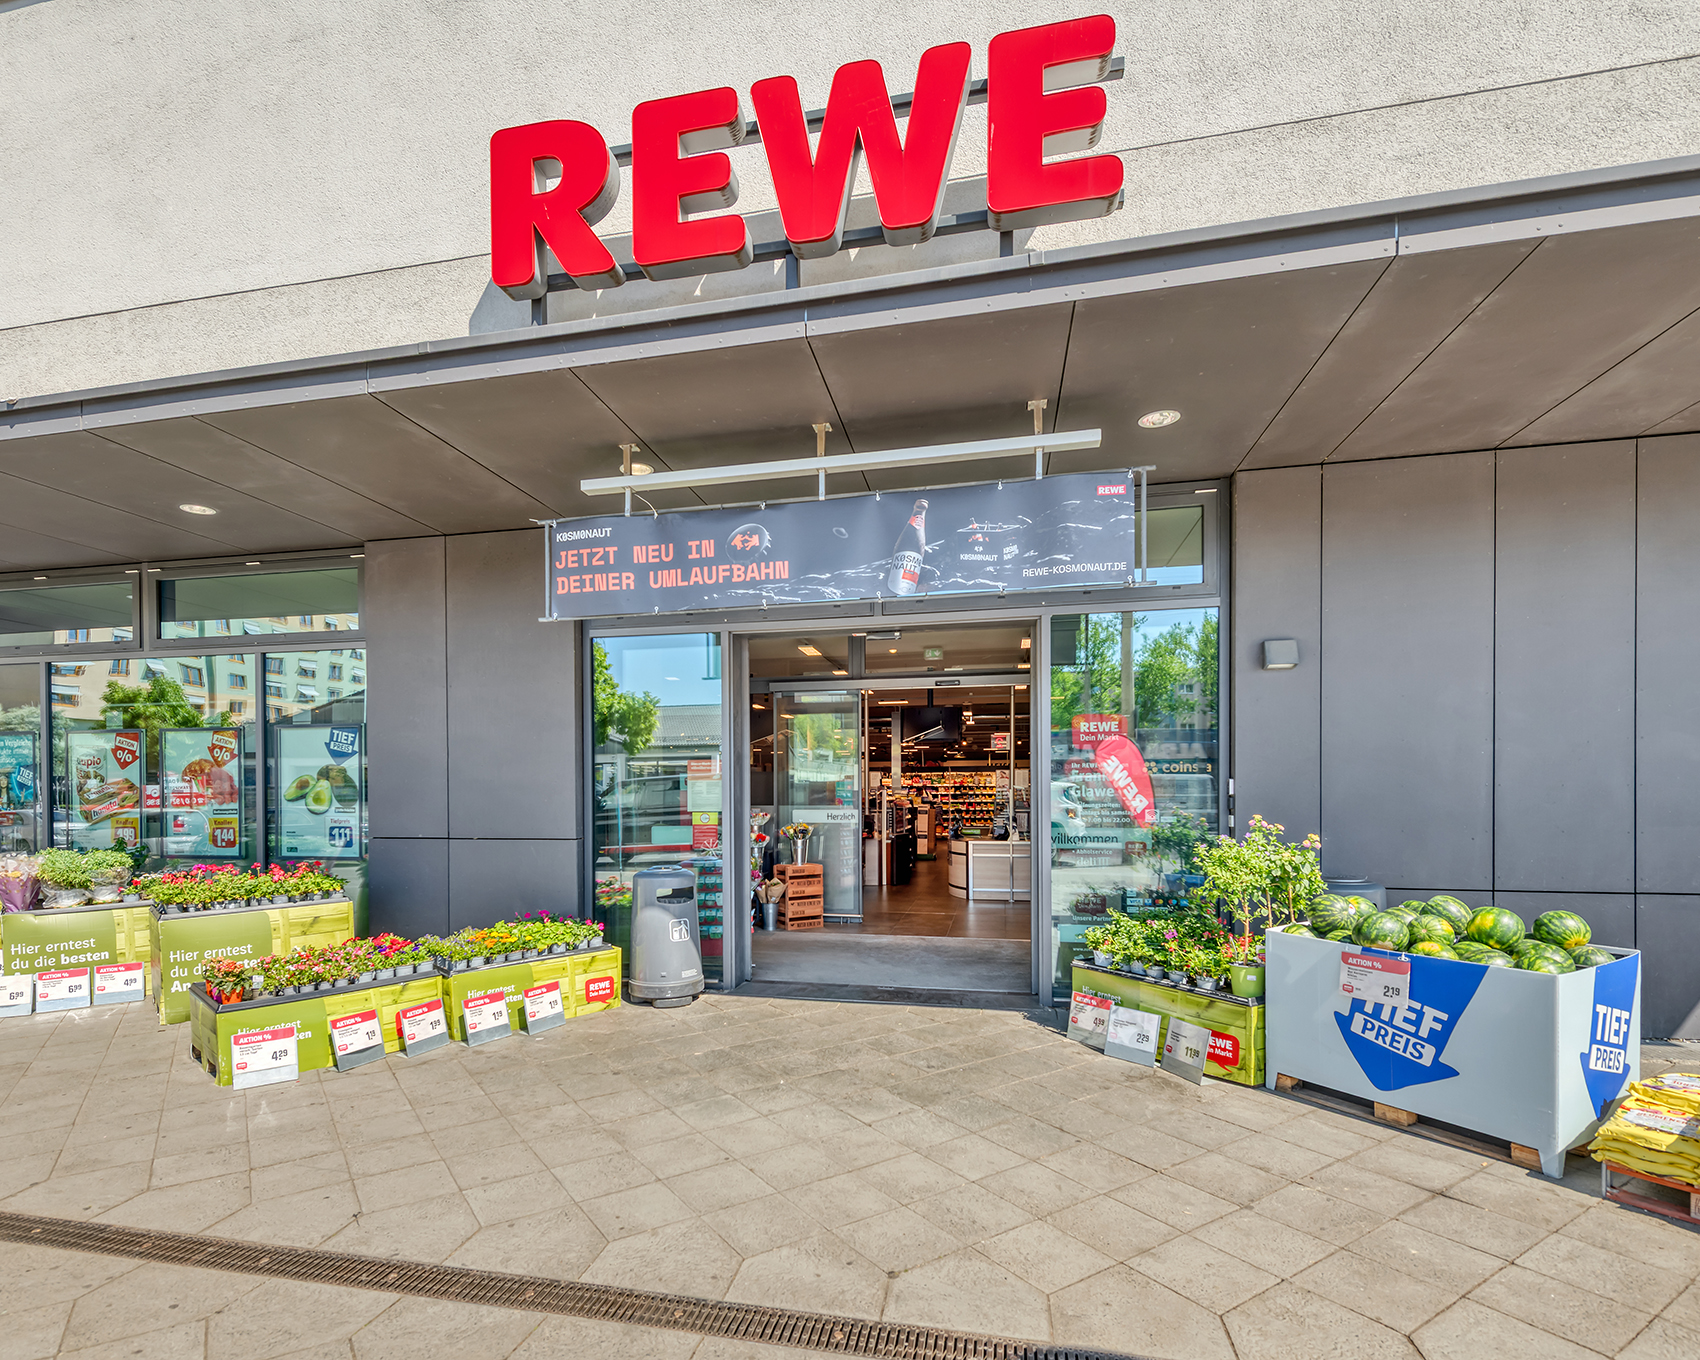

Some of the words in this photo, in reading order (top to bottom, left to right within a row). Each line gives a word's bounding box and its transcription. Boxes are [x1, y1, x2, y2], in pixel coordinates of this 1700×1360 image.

[490, 14, 1124, 297] REWE
[1098, 485, 1126, 495] REWE
[555, 546, 619, 570] JETZT
[633, 543, 674, 564] NEU
[687, 539, 715, 559] IN
[1022, 561, 1127, 577] REWE-KOSMONAUT.DE
[556, 571, 636, 595] DEINER
[649, 560, 790, 590] UMLAUFBAHN
[1080, 721, 1120, 733] REWE
[215, 736, 233, 746] AKTION
[332, 729, 356, 745] TIEF
[1080, 733, 1096, 742] Dein
[1097, 733, 1119, 742] Markt
[118, 738, 136, 749] AKTION
[332, 742, 351, 752] PREIS
[116, 749, 133, 763] %
[213, 748, 230, 761] %
[1072, 784, 1116, 798] Glawe
[826, 811, 856, 821] Herzlich
[214, 828, 235, 847] 1.44
[10, 942, 40, 956] Hier
[45, 937, 96, 953] erntest
[169, 949, 200, 963] Hier
[203, 943, 253, 959] erntest
[11, 957, 29, 970] du
[34, 953, 56, 968] die
[60, 951, 110, 965] besten
[1347, 957, 1373, 967] AKTION
[1373, 961, 1382, 969] %
[170, 965, 188, 978] du
[123, 978, 137, 987] 4.99
[588, 980, 611, 992] REWE
[68, 984, 82, 994] 6.99
[467, 989, 485, 999] Hier
[1082, 985, 1096, 996] Hier
[1383, 985, 1401, 998] 2.19
[9, 991, 24, 1001] 6.99
[492, 1010, 503, 1021] 1.19
[429, 1019, 441, 1030] 1.99
[1595, 1004, 1631, 1045] TIEF
[239, 1035, 263, 1044] AKTION
[365, 1029, 376, 1041] 1.19
[1136, 1033, 1150, 1044] 2.29
[1360, 1017, 1426, 1061] PREIS
[1208, 1036, 1233, 1051] EWE
[271, 1049, 288, 1061] 4.29
[1184, 1046, 1200, 1059] 11.99
[1214, 1047, 1233, 1059] Markt
[1594, 1047, 1624, 1071] PREIS
